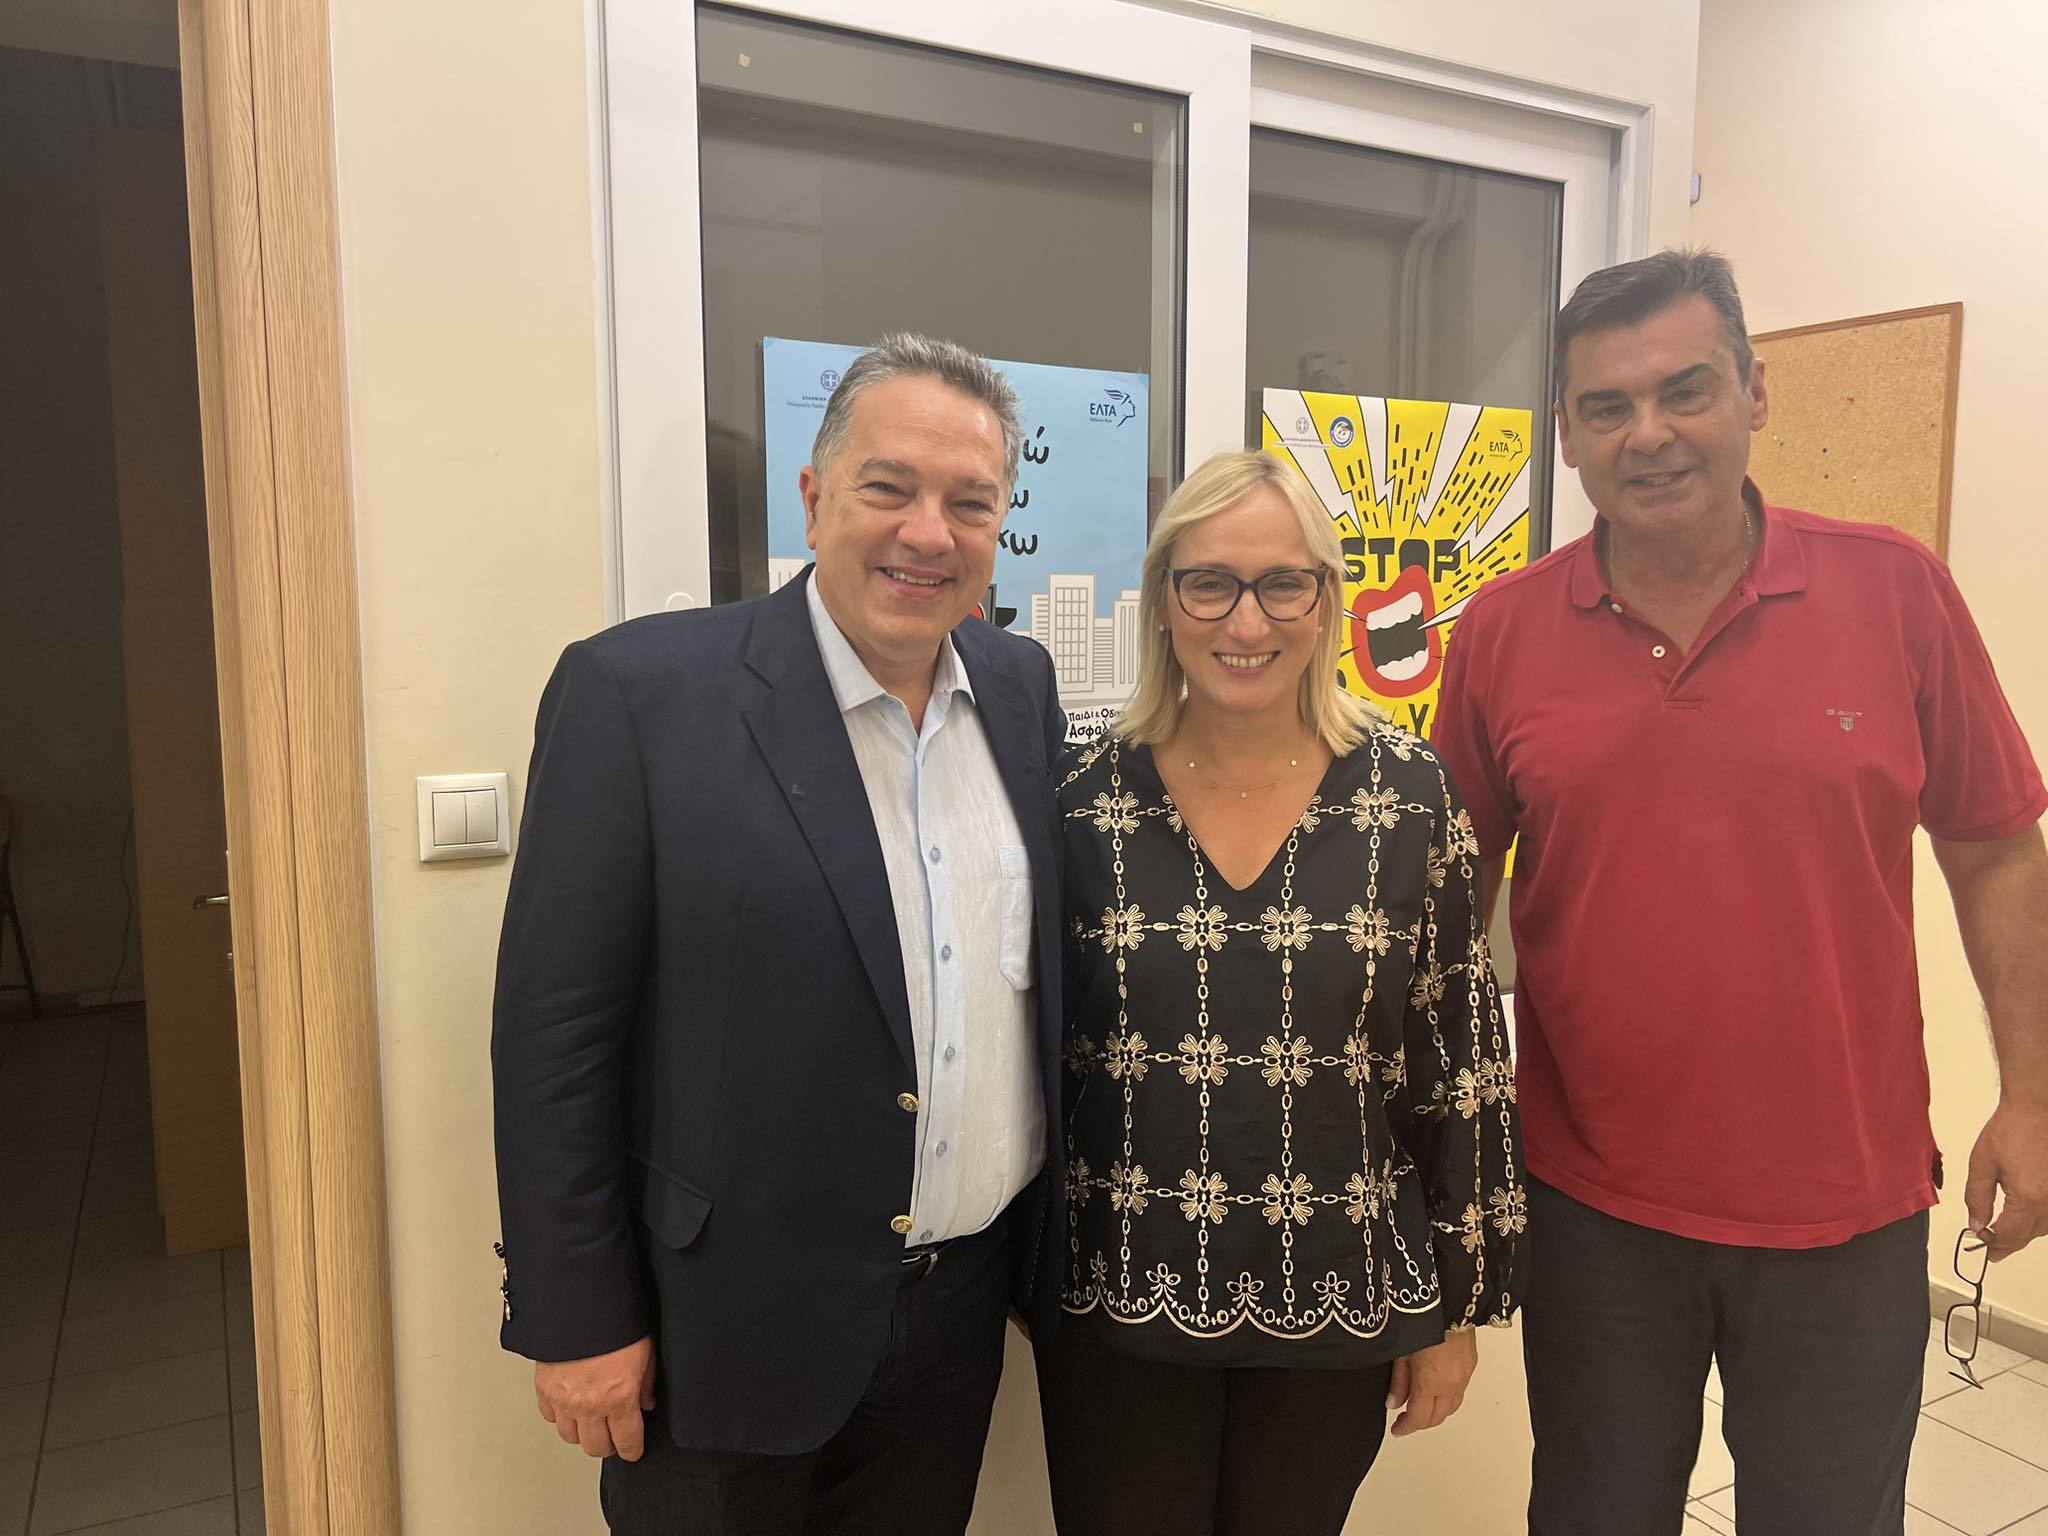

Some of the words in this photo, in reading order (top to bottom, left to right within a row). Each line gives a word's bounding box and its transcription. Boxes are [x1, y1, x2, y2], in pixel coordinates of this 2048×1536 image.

[1089, 402, 1117, 417] ΕΛΤΑ
[1340, 537, 1461, 583] STOP
[1069, 720, 1108, 740] Ασφάλ
